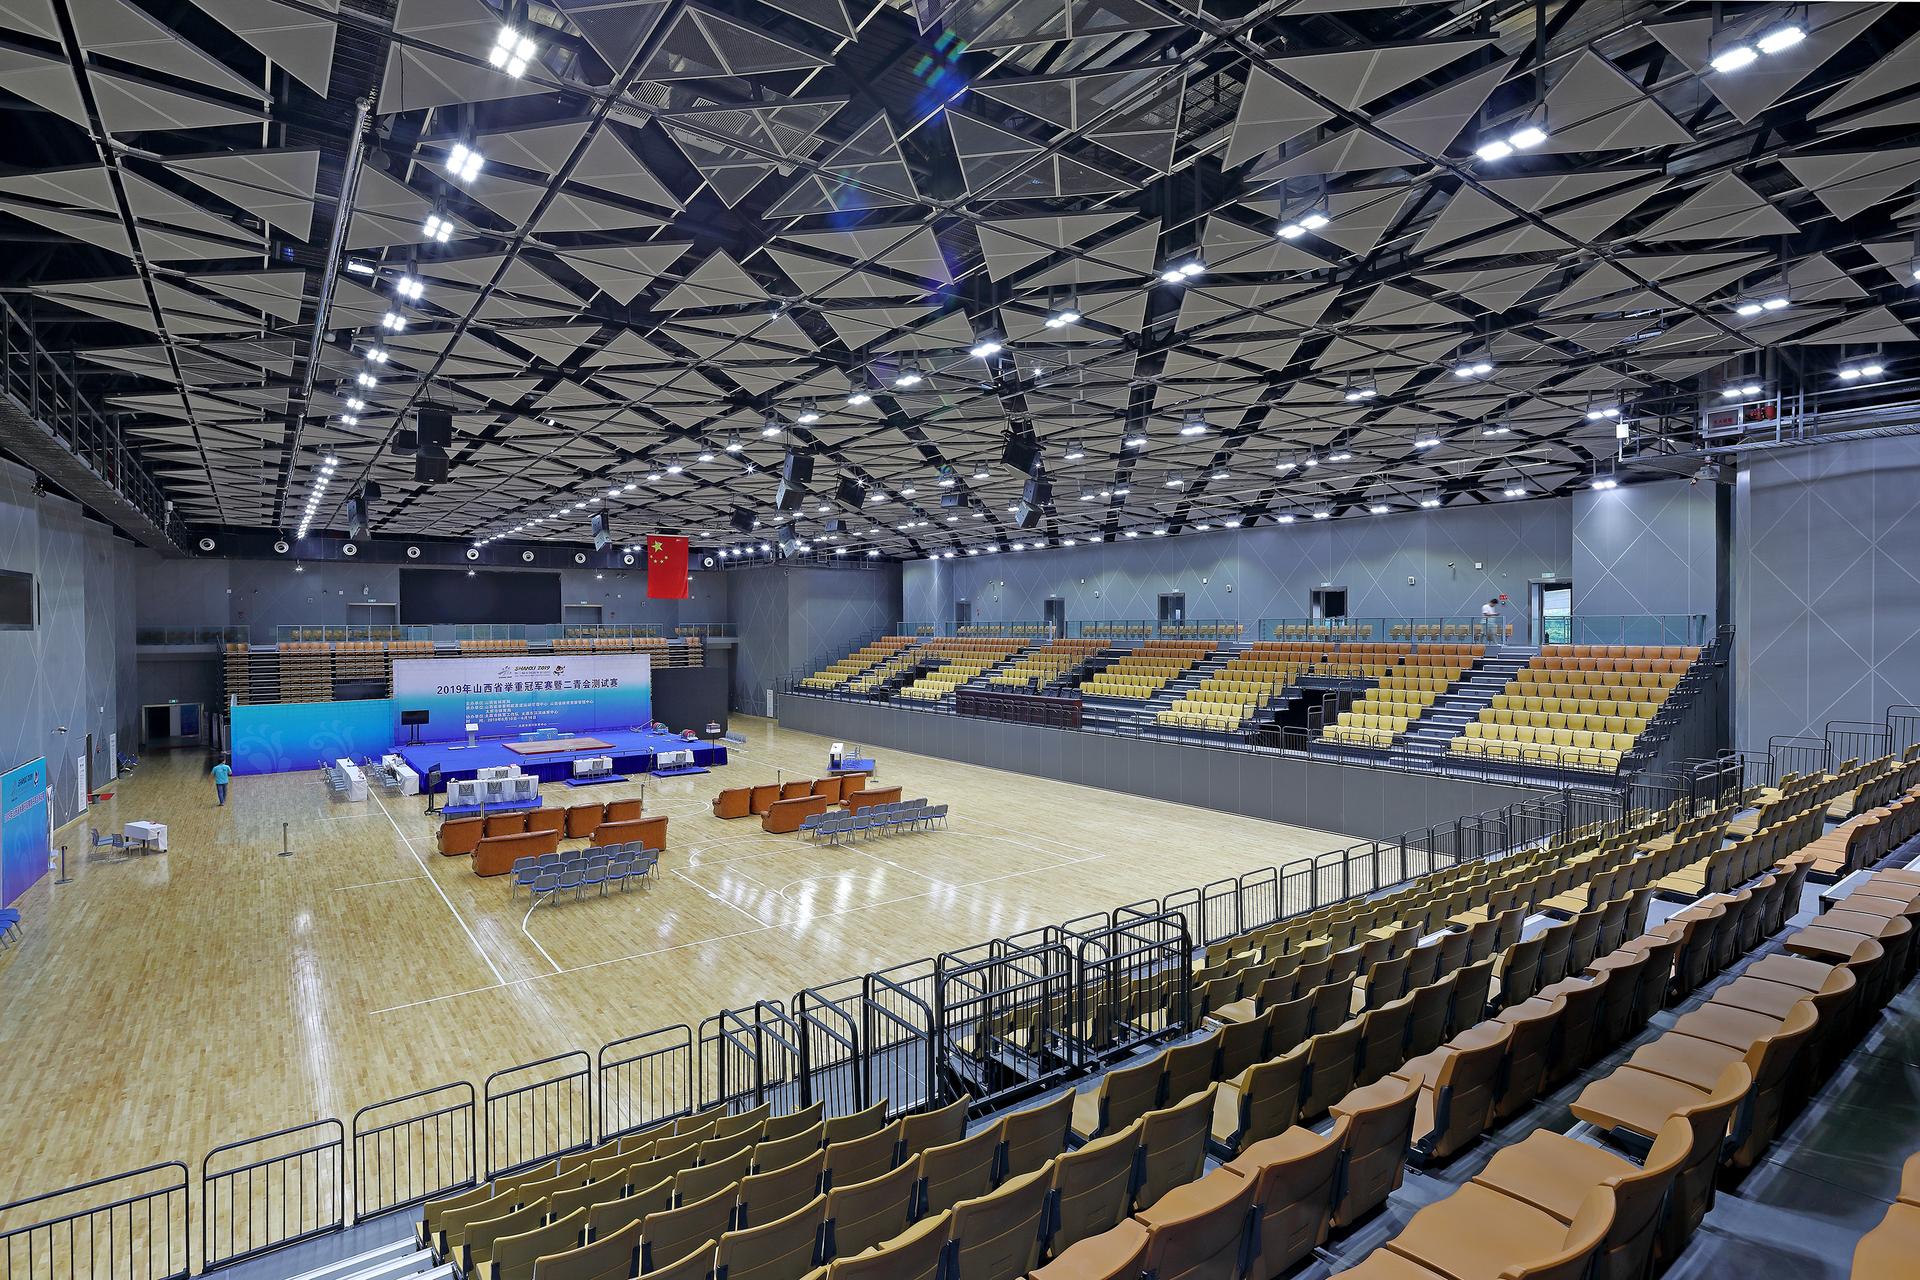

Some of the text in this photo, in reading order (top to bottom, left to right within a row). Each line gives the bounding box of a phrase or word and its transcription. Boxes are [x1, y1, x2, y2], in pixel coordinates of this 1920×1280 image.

[437, 678, 618, 695] 2019年山西省举重冠军赛暨二青会测试赛
